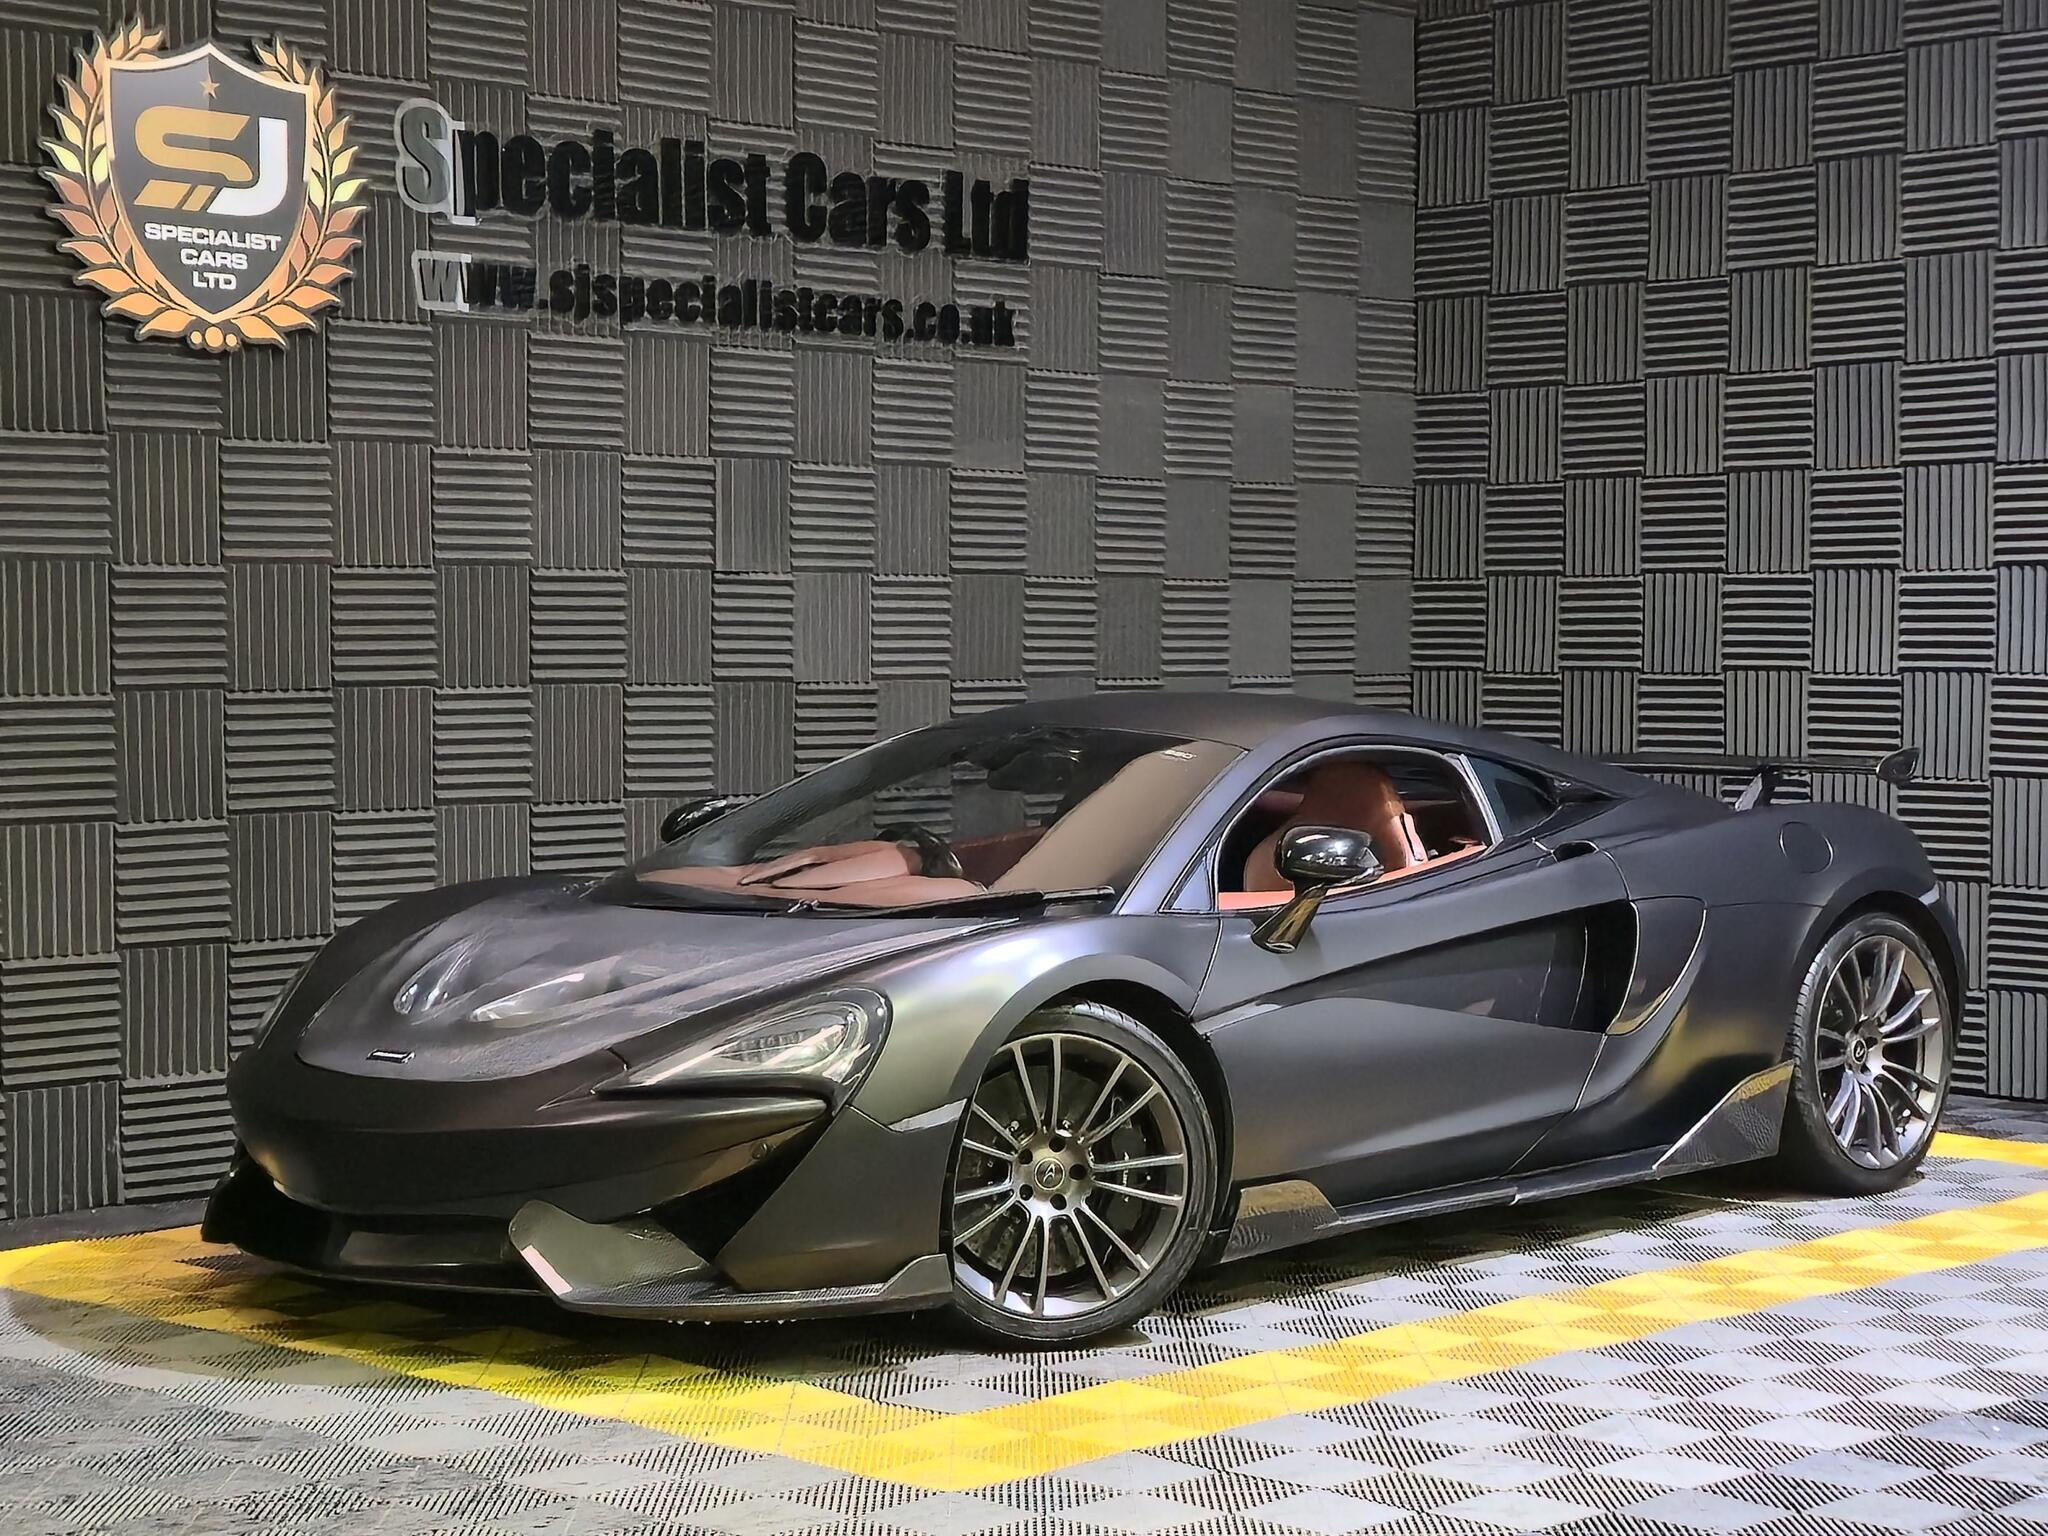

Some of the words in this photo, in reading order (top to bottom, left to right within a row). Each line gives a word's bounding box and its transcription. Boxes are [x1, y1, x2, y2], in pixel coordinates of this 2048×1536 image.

[134, 104, 288, 217] SJ
[398, 102, 772, 238] Specialist
[786, 151, 932, 251] Cars
[943, 170, 1030, 260] Ltd
[144, 222, 281, 252] SPECIALIST
[180, 248, 248, 270] CARS
[192, 271, 237, 290] LTD
